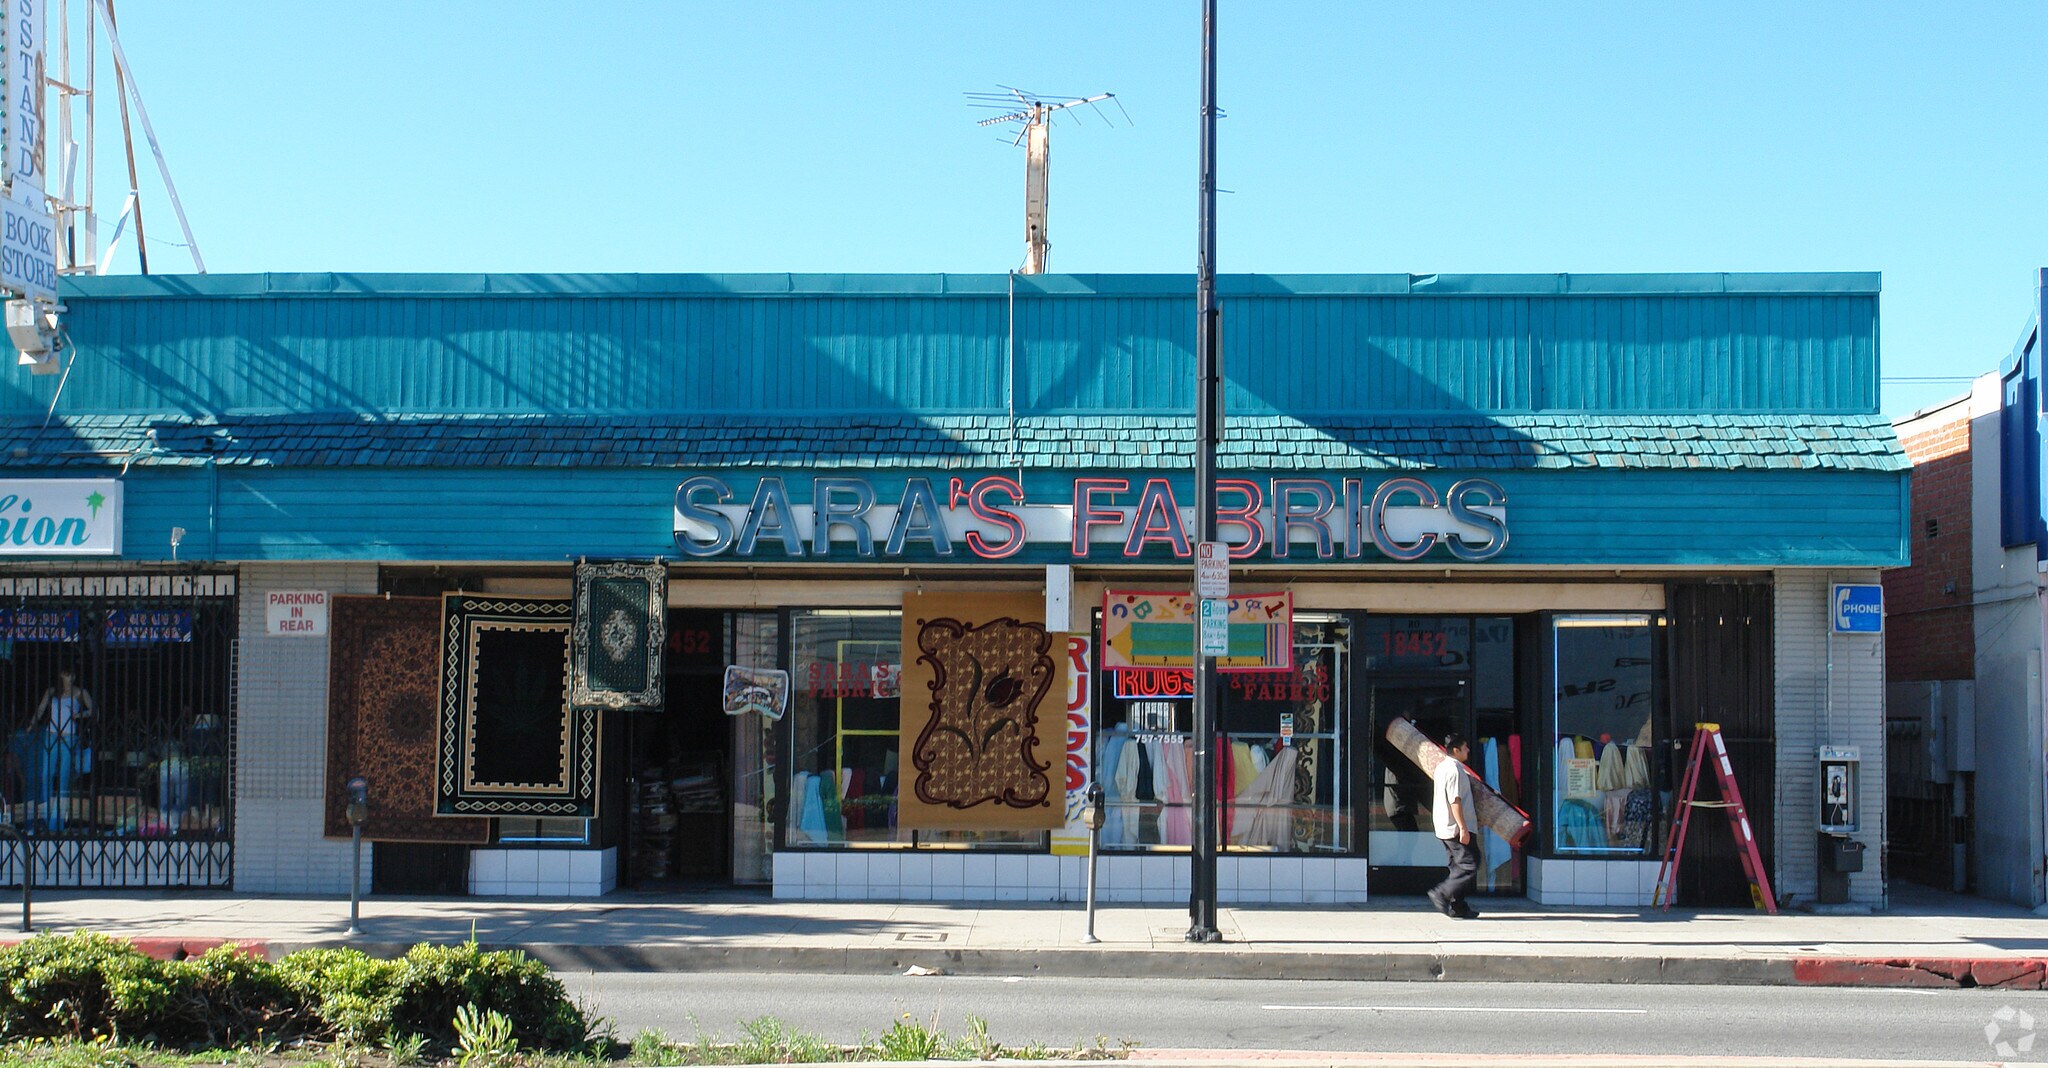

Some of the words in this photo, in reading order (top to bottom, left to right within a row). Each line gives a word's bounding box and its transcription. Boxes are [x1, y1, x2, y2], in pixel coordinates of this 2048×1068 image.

[5, 211, 52, 256] BOOK
[2, 245, 57, 291] STORE
[674, 475, 1026, 558] SARA'S
[1072, 476, 1509, 561] FABRICS
[1201, 545, 1212, 558] NO
[1201, 559, 1227, 570] PARKING
[270, 593, 325, 605] PARKING
[291, 607, 303, 618] IN
[1203, 602, 1210, 615] 2
[1843, 604, 1881, 614] PHONE
[279, 620, 314, 631] REAR
[1203, 619, 1227, 630] PARKING
[1382, 632, 1448, 657] 18452
[809, 661, 890, 680] SARAS
[808, 680, 891, 698] FABRIC
[1243, 683, 1330, 702] FABRIC
[1134, 734, 1184, 744] 757-7555
